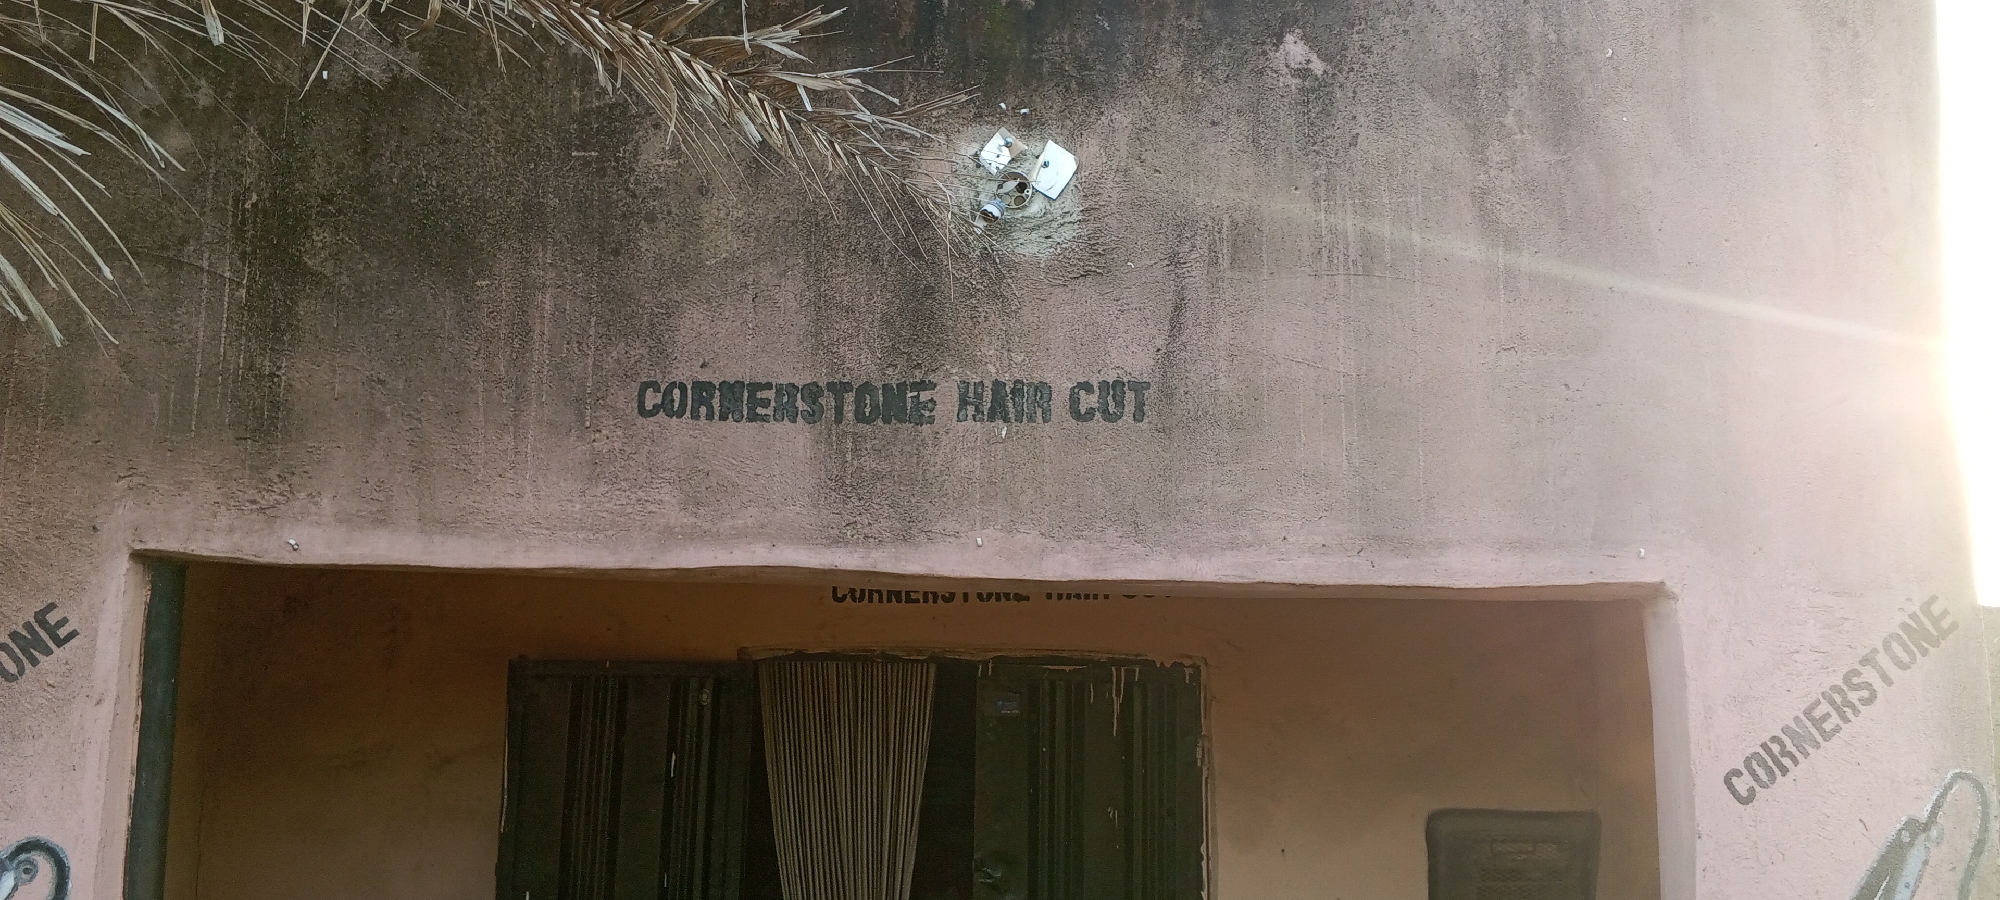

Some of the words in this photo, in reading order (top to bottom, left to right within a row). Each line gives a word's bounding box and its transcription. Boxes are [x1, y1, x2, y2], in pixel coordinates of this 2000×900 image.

[637, 380, 937, 425] CORNERSTONE
[957, 379, 1052, 423] HAIR
[1069, 380, 1150, 423] CUT
[1723, 594, 1959, 806] CORNERSTONE
